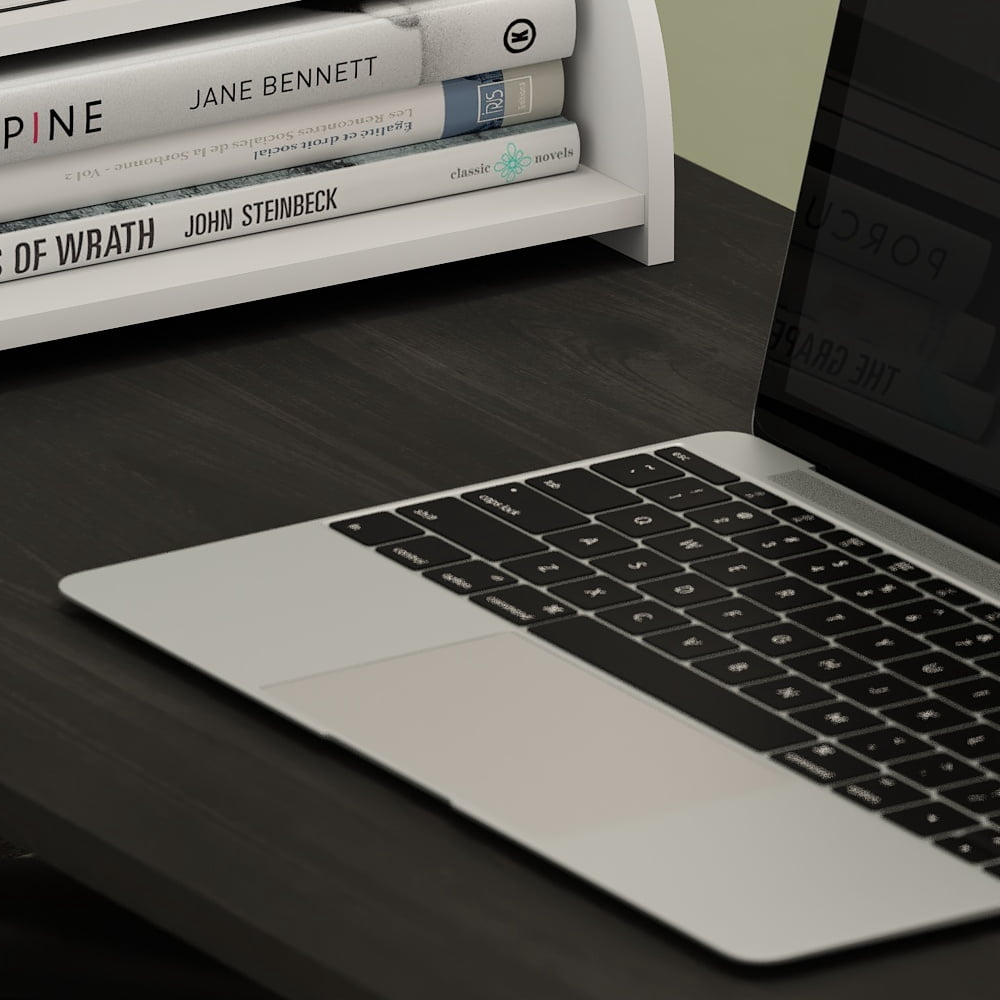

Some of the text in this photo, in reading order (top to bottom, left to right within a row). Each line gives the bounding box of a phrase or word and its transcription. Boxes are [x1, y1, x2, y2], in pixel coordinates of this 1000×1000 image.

[189, 55, 378, 110] JANE BENNETT
[388, 108, 414, 120] Les
[297, 114, 385, 136] Rencontres
[231, 129, 295, 149] Sociales
[300, 135, 340, 149] droit
[342, 132, 358, 143] et
[193, 148, 207, 158] la
[209, 143, 230, 154] de
[253, 143, 299, 160] social
[114, 150, 190, 172] Sorbonne
[450, 147, 574, 180] classic novels
[76, 168, 101, 182] Vol
[14, 238, 47, 274] OF
[55, 217, 155, 266] WRATH
[184, 207, 233, 238] JOHN
[241, 187, 338, 227] STEINBECK
